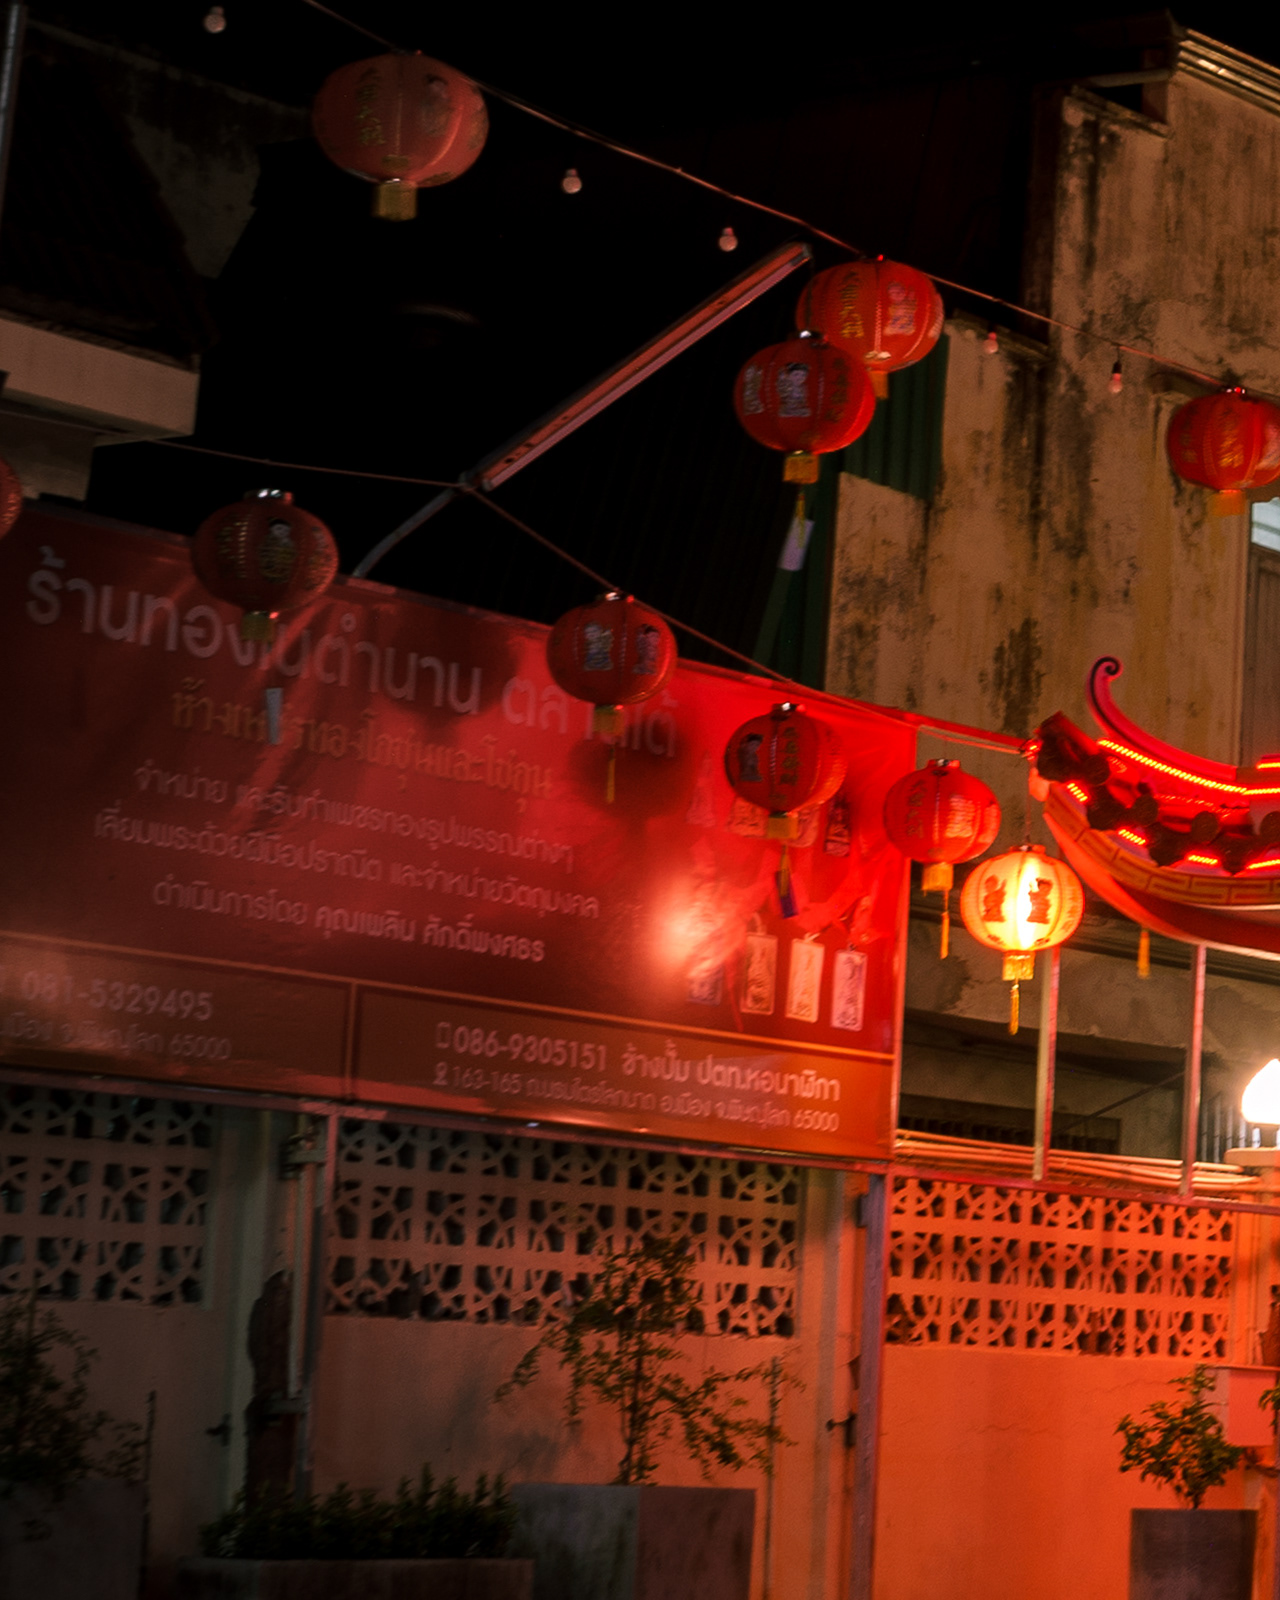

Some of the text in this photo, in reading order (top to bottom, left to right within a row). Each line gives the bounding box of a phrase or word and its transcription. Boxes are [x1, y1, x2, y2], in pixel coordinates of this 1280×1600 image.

[26, 545, 482, 715] ร้านทองนตำนาน
[453, 1025, 607, 1073] 086-9305151
